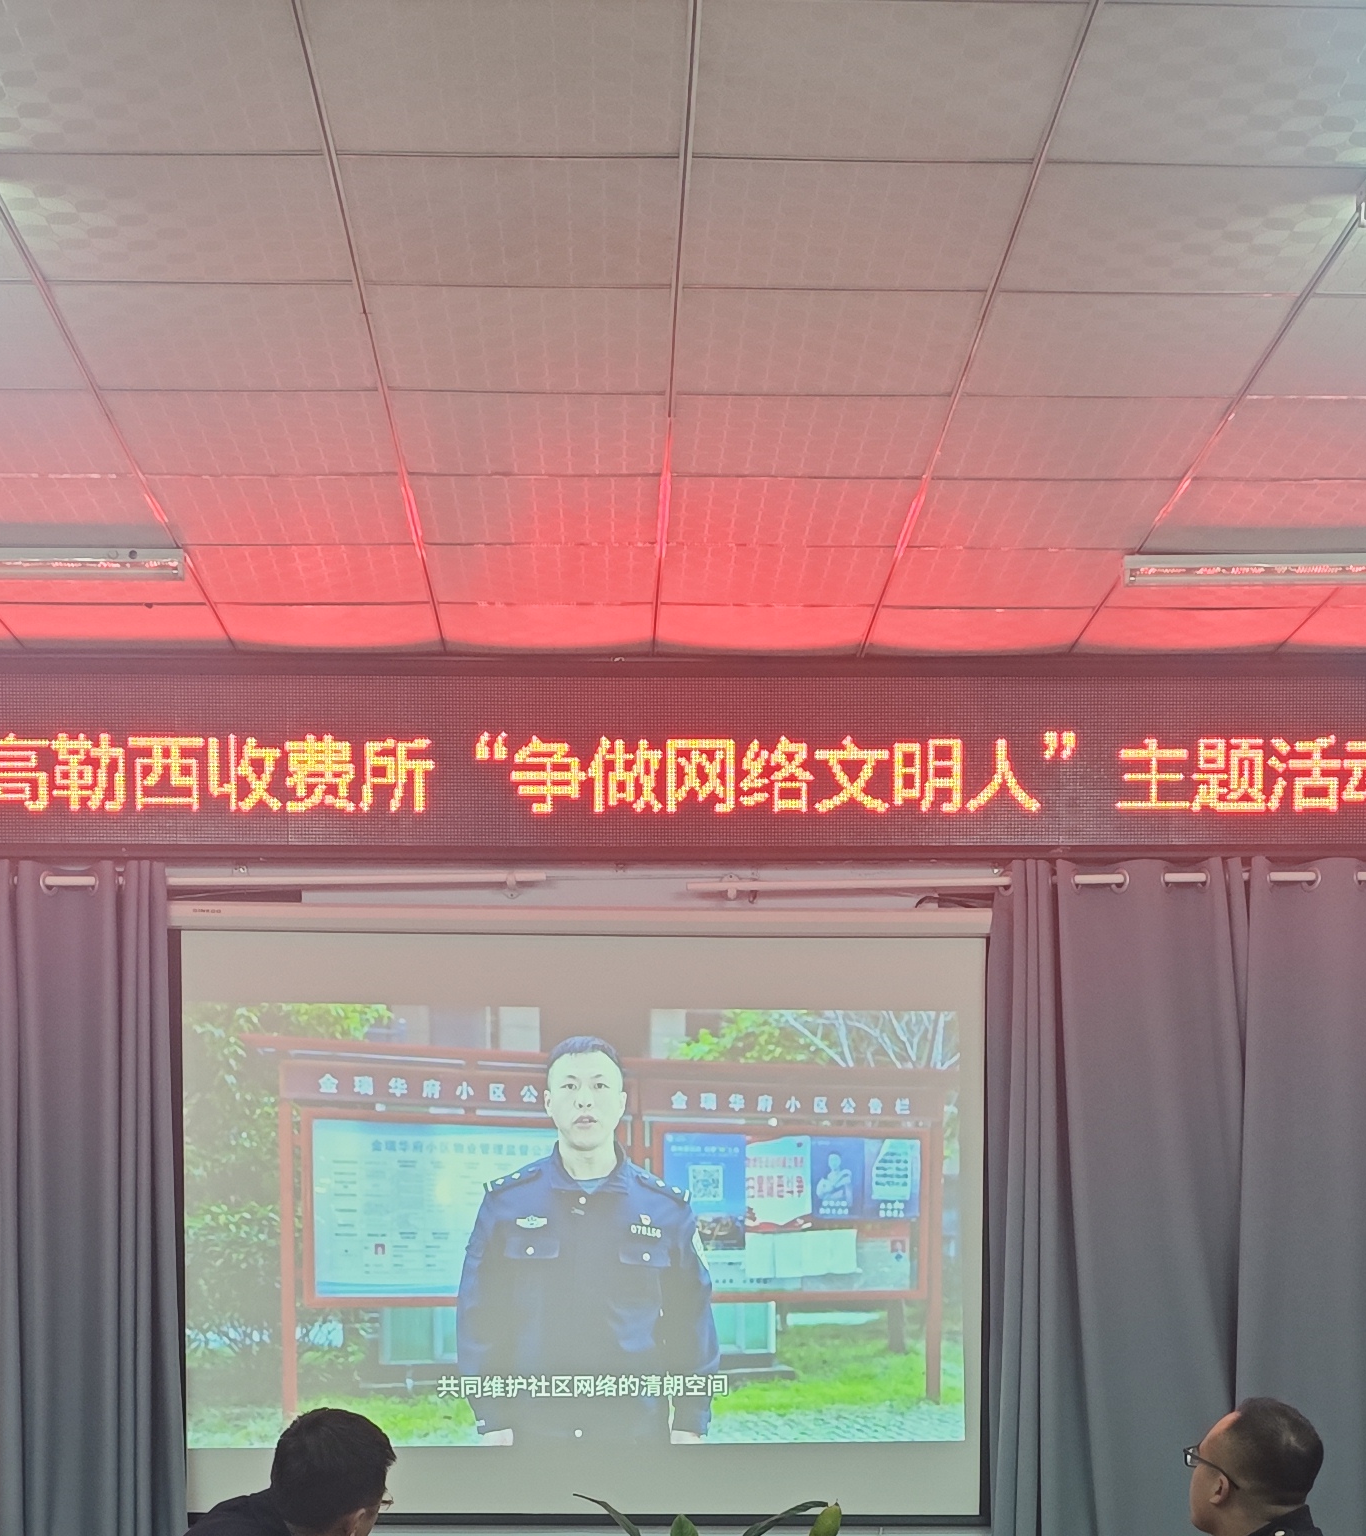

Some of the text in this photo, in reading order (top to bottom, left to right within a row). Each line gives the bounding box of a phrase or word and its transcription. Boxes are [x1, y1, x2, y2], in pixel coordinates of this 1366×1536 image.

[436, 1374, 730, 1398] 共同维护社区网络的清朗空间
